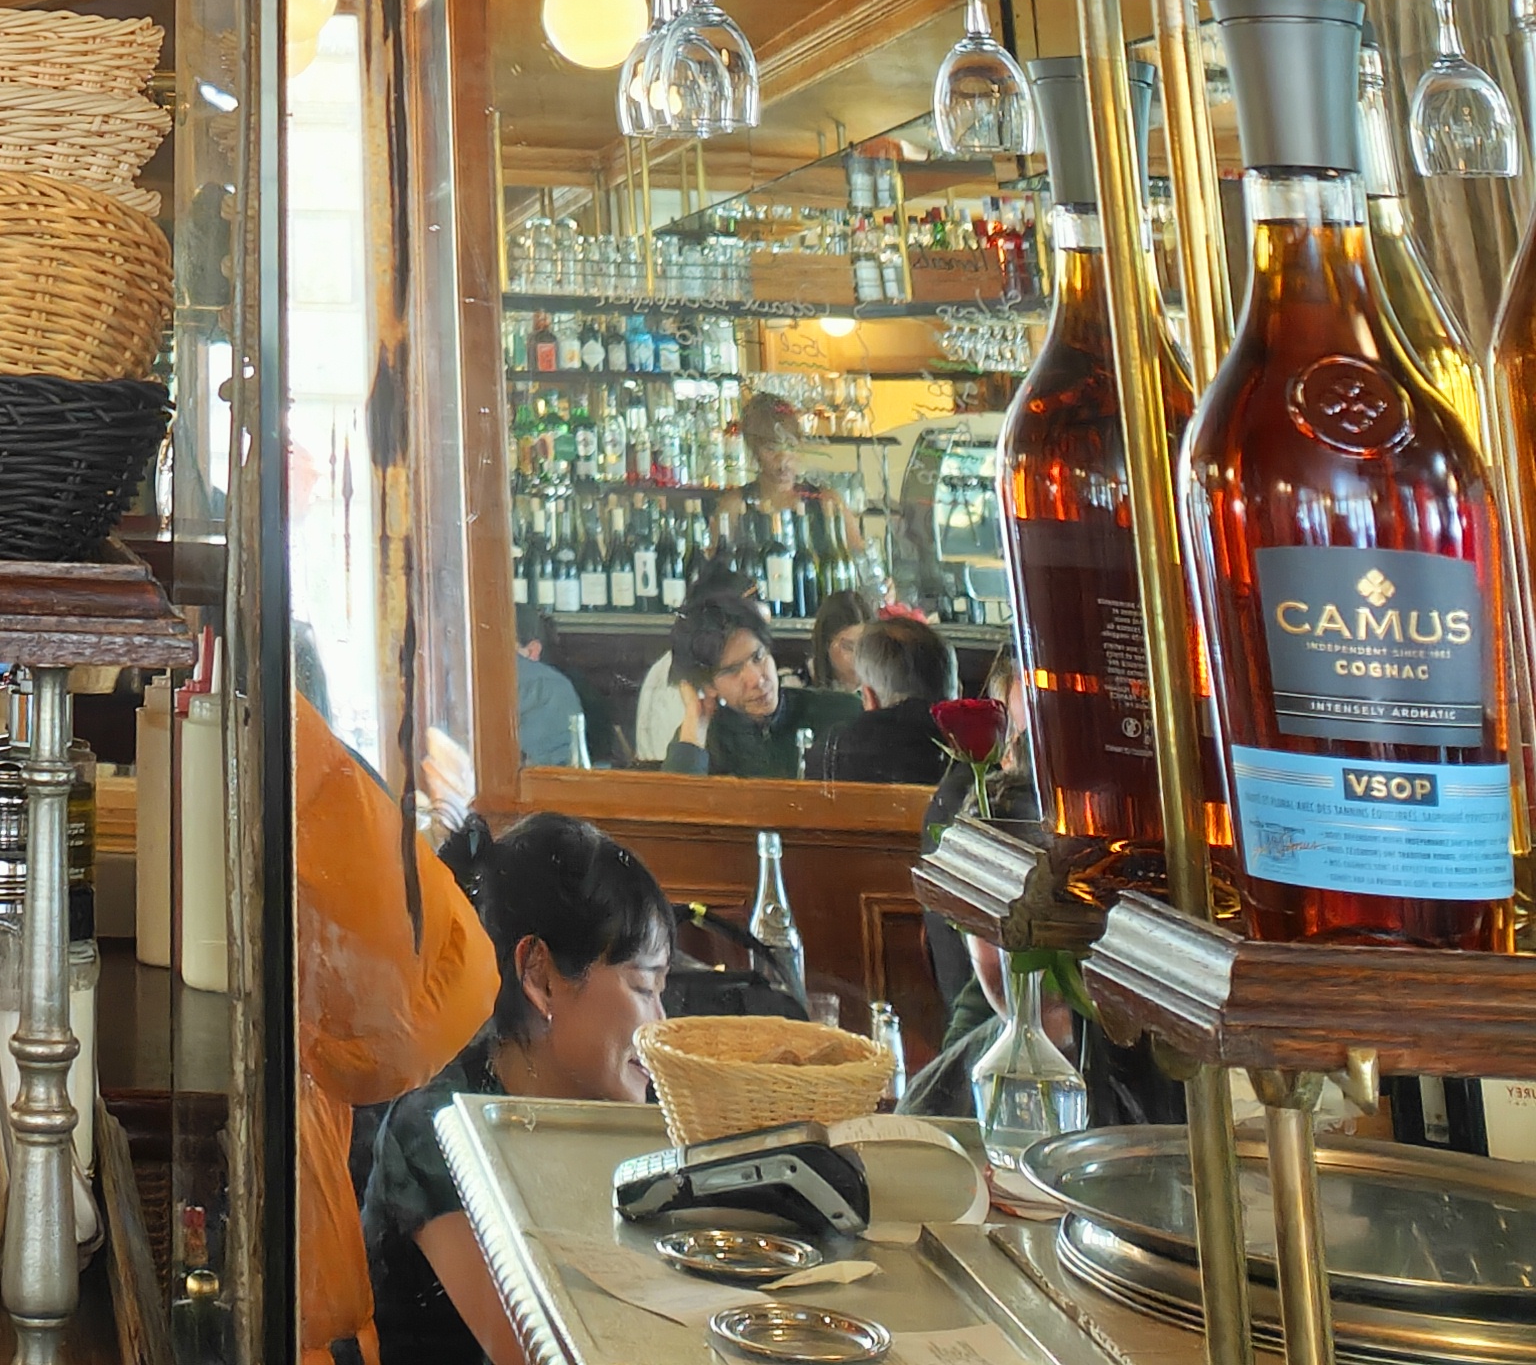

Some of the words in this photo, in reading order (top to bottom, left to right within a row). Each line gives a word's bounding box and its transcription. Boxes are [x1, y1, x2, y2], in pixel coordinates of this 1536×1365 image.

[1275, 599, 1473, 646] CAMUS
[1334, 658, 1430, 681] COGNAC
[1310, 701, 1385, 718] INTENSELY
[1391, 706, 1457, 721] AROMATIC
[1346, 772, 1432, 801] VSOP
